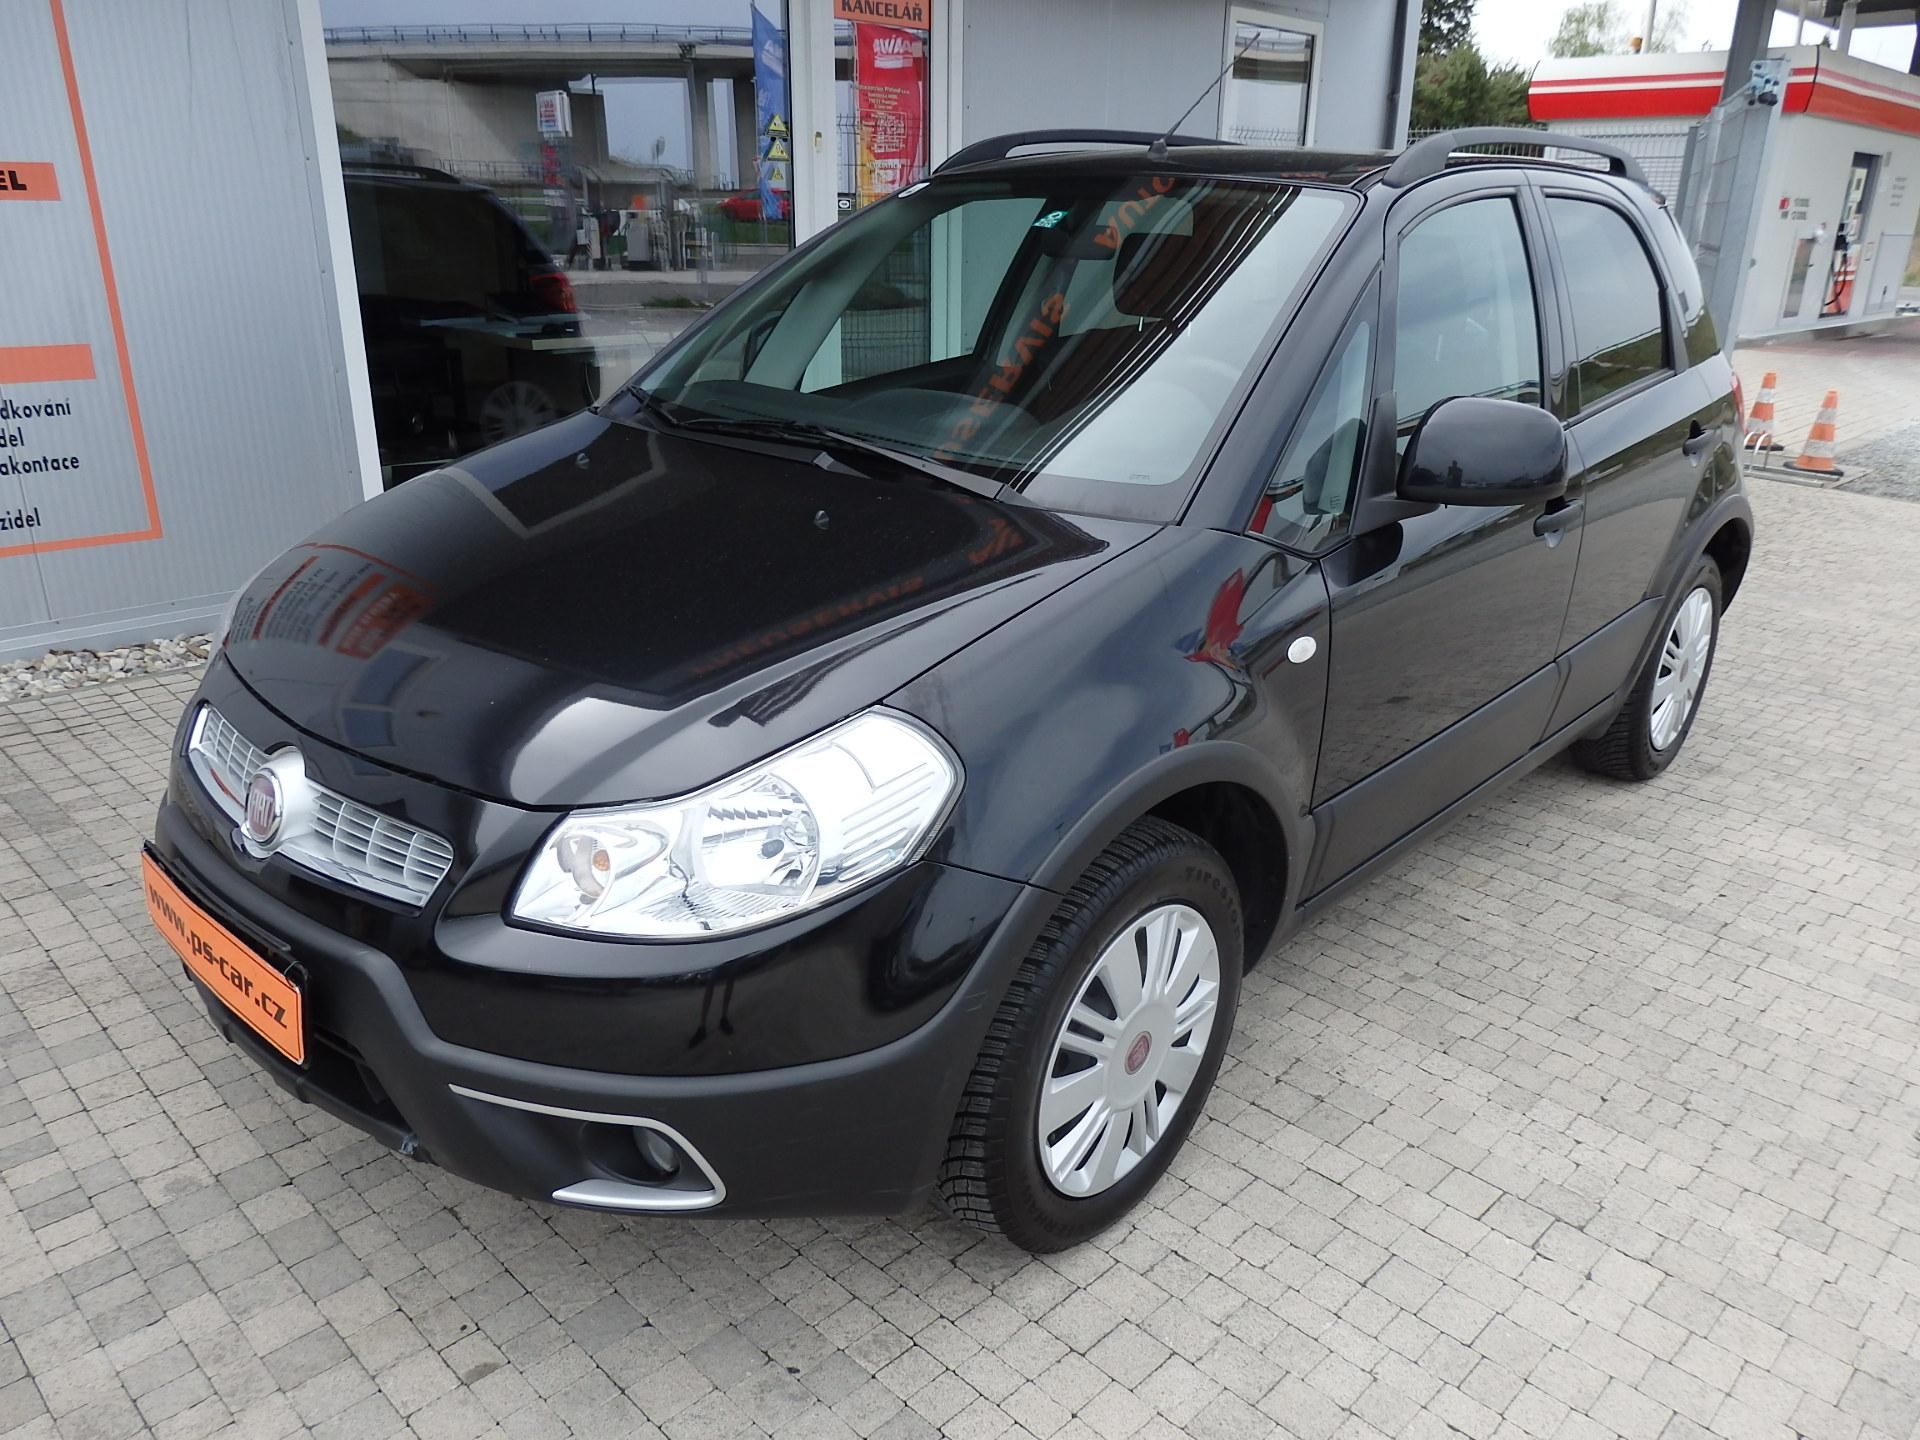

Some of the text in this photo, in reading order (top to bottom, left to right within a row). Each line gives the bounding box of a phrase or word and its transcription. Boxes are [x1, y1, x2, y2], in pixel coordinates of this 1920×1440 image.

[842, 0, 922, 21] KANCELÁŘ
[0, 455, 80, 476] akontace
[149, 884, 288, 1029] www.ps-car.cz
